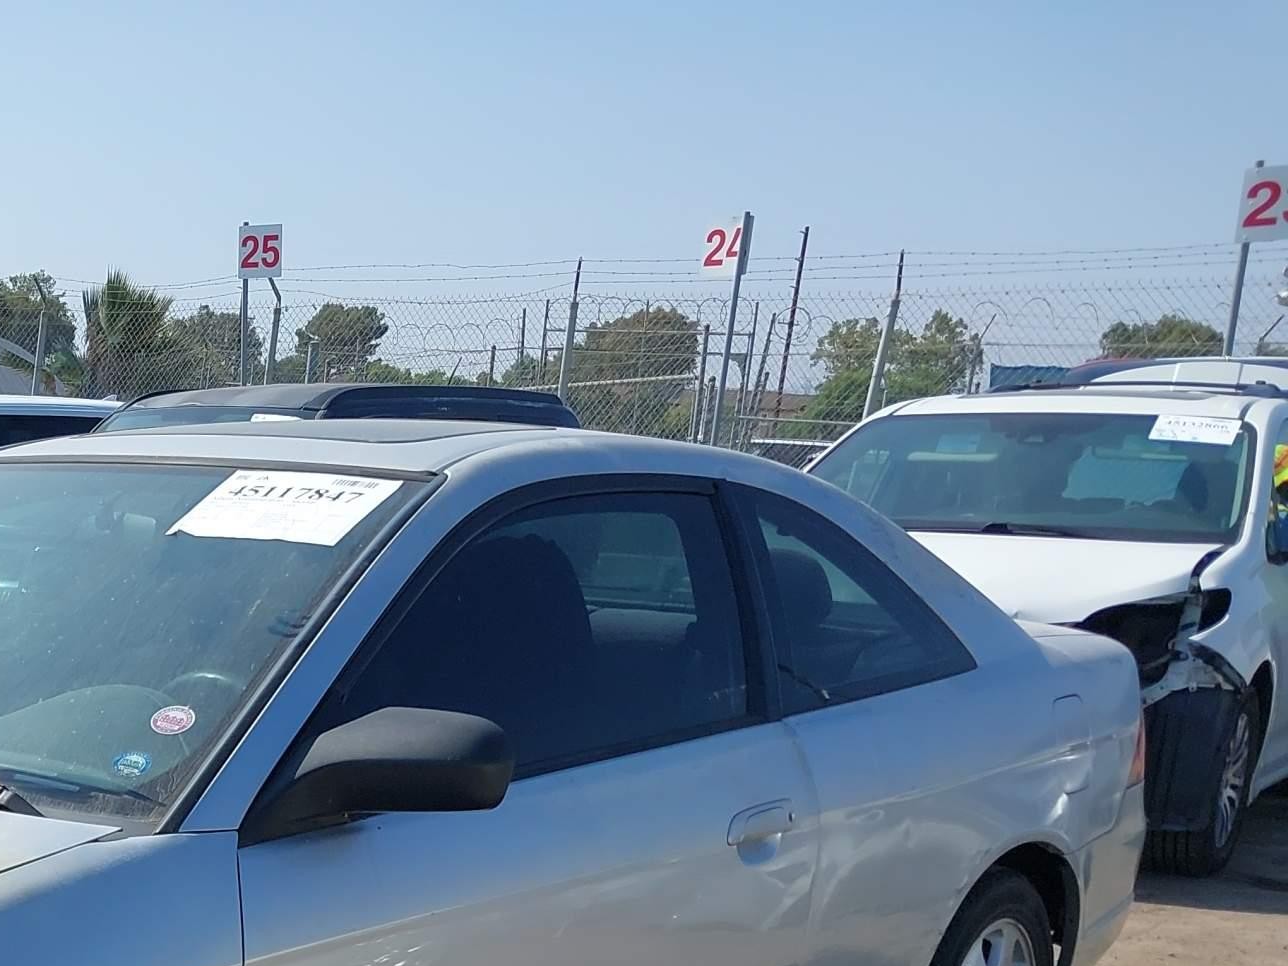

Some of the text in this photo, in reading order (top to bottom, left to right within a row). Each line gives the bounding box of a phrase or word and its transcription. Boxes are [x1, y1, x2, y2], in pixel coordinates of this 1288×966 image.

[1242, 181, 1288, 227] 2
[240, 234, 280, 269] 25
[228, 485, 365, 504] 45117847
